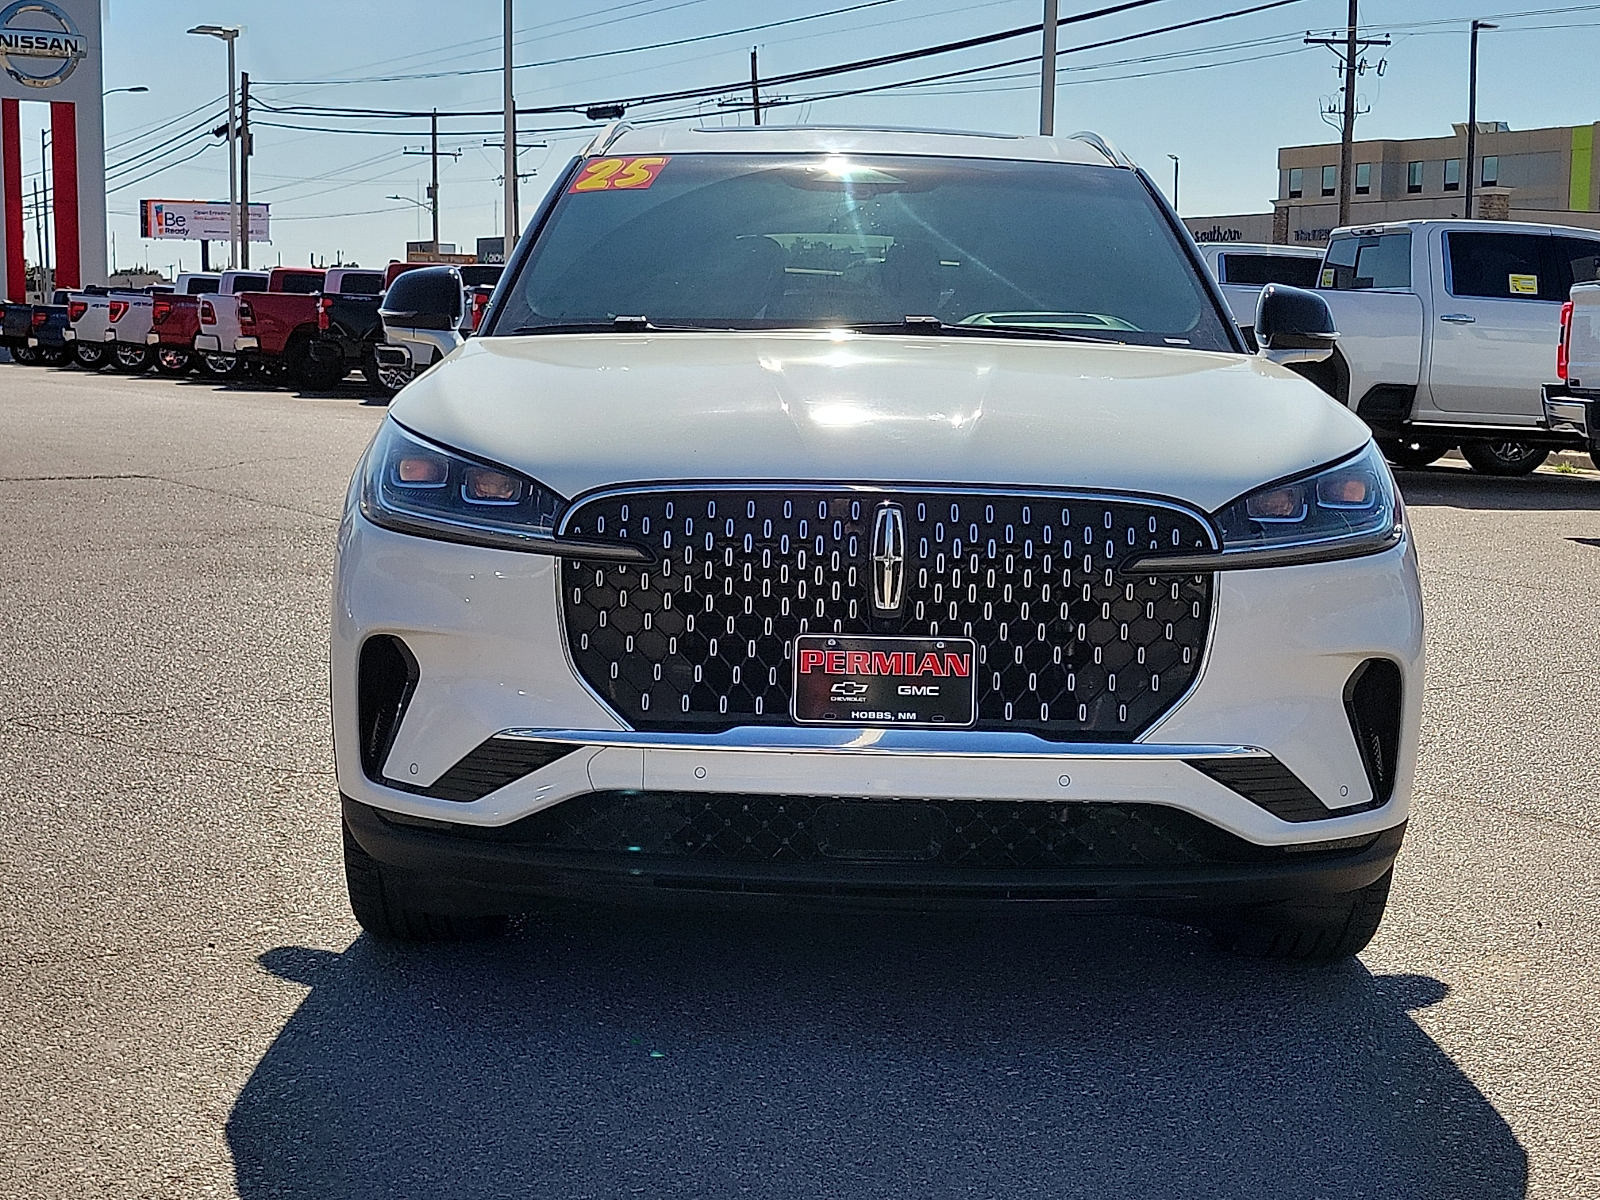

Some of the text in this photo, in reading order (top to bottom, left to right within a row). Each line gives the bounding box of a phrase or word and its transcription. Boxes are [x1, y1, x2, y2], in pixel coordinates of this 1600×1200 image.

[0, 34, 78, 52] NISSAN
[576, 157, 667, 190] 25
[164, 212, 186, 227] Be
[164, 227, 190, 236] Ready
[1194, 226, 1242, 242] southern
[800, 649, 971, 677] PERMIAN
[897, 685, 940, 696] GMC
[851, 711, 917, 721] HOBBS, NM
